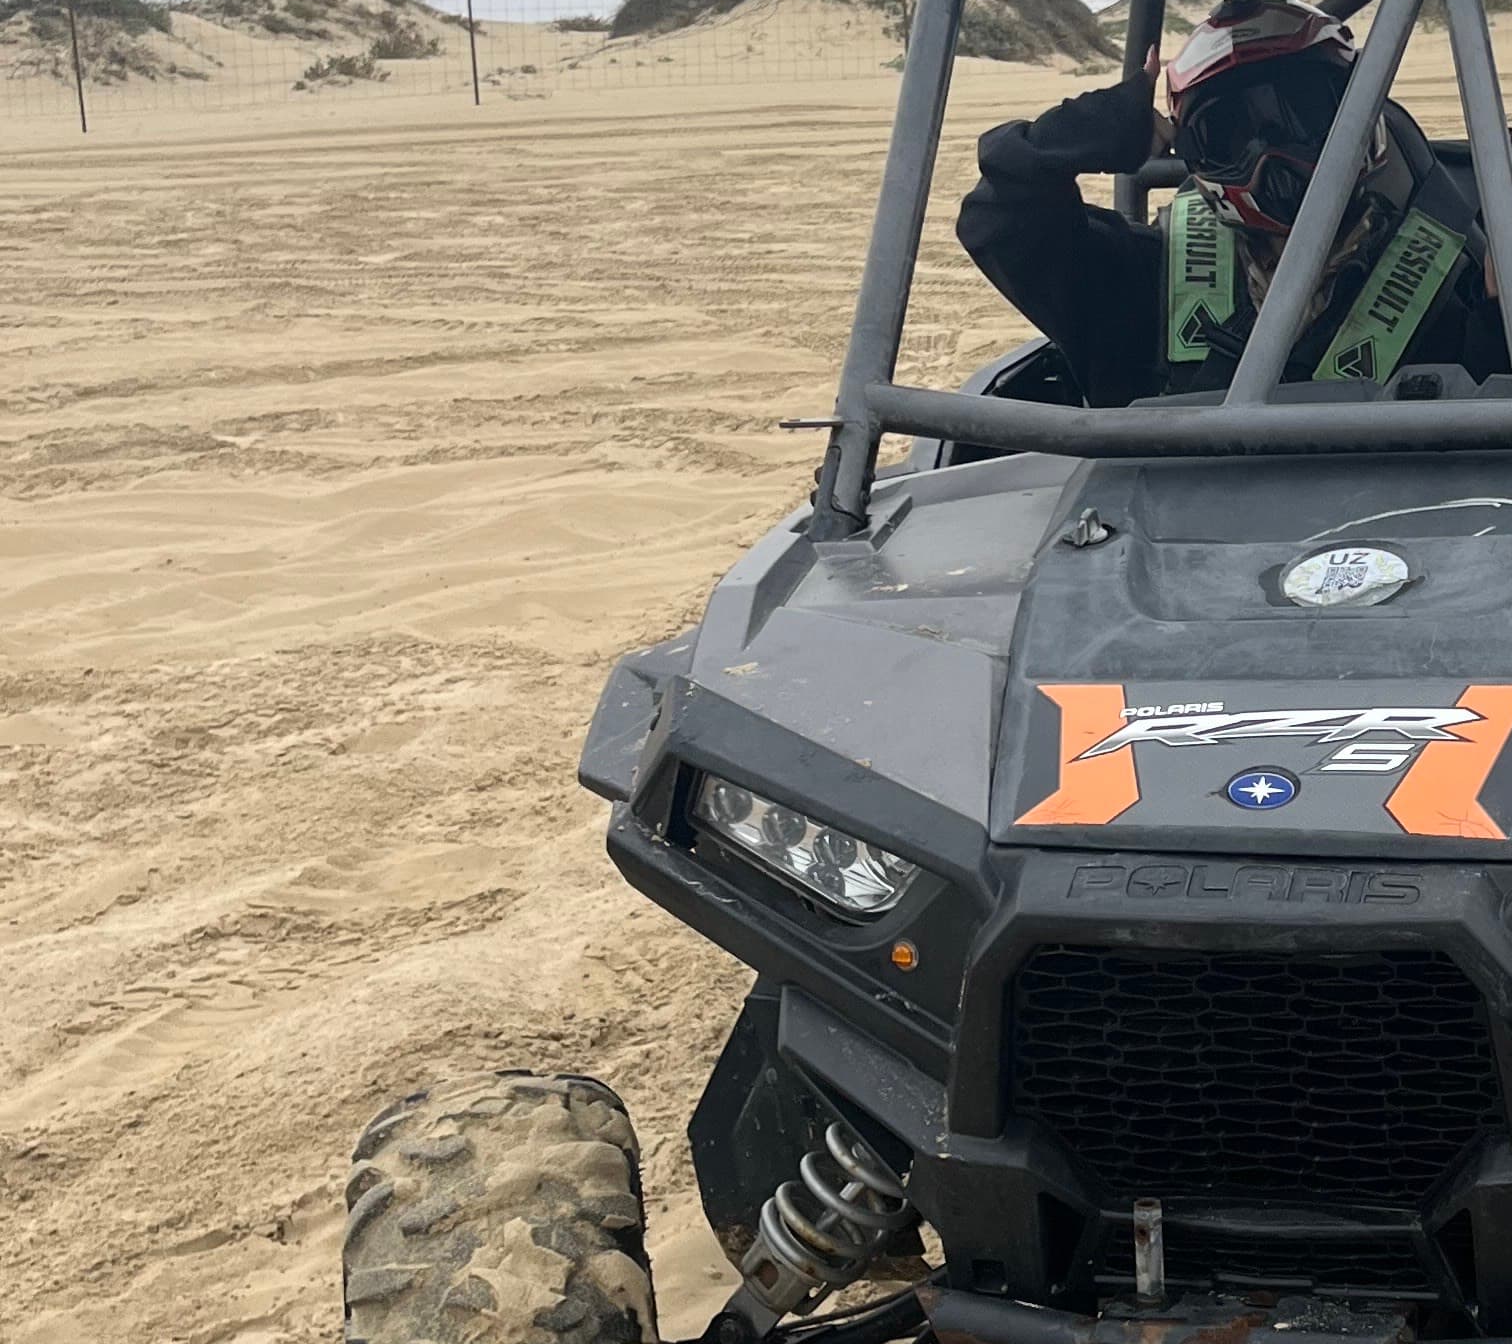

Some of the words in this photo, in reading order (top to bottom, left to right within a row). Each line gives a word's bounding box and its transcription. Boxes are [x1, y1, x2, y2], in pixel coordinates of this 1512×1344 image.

[1368, 225, 1444, 334] ASSAULT
[1328, 552, 1371, 566] UZ
[1119, 701, 1225, 719] POLARIS
[1067, 706, 1488, 764] RZR
[1066, 864, 1423, 905] POLARIS
